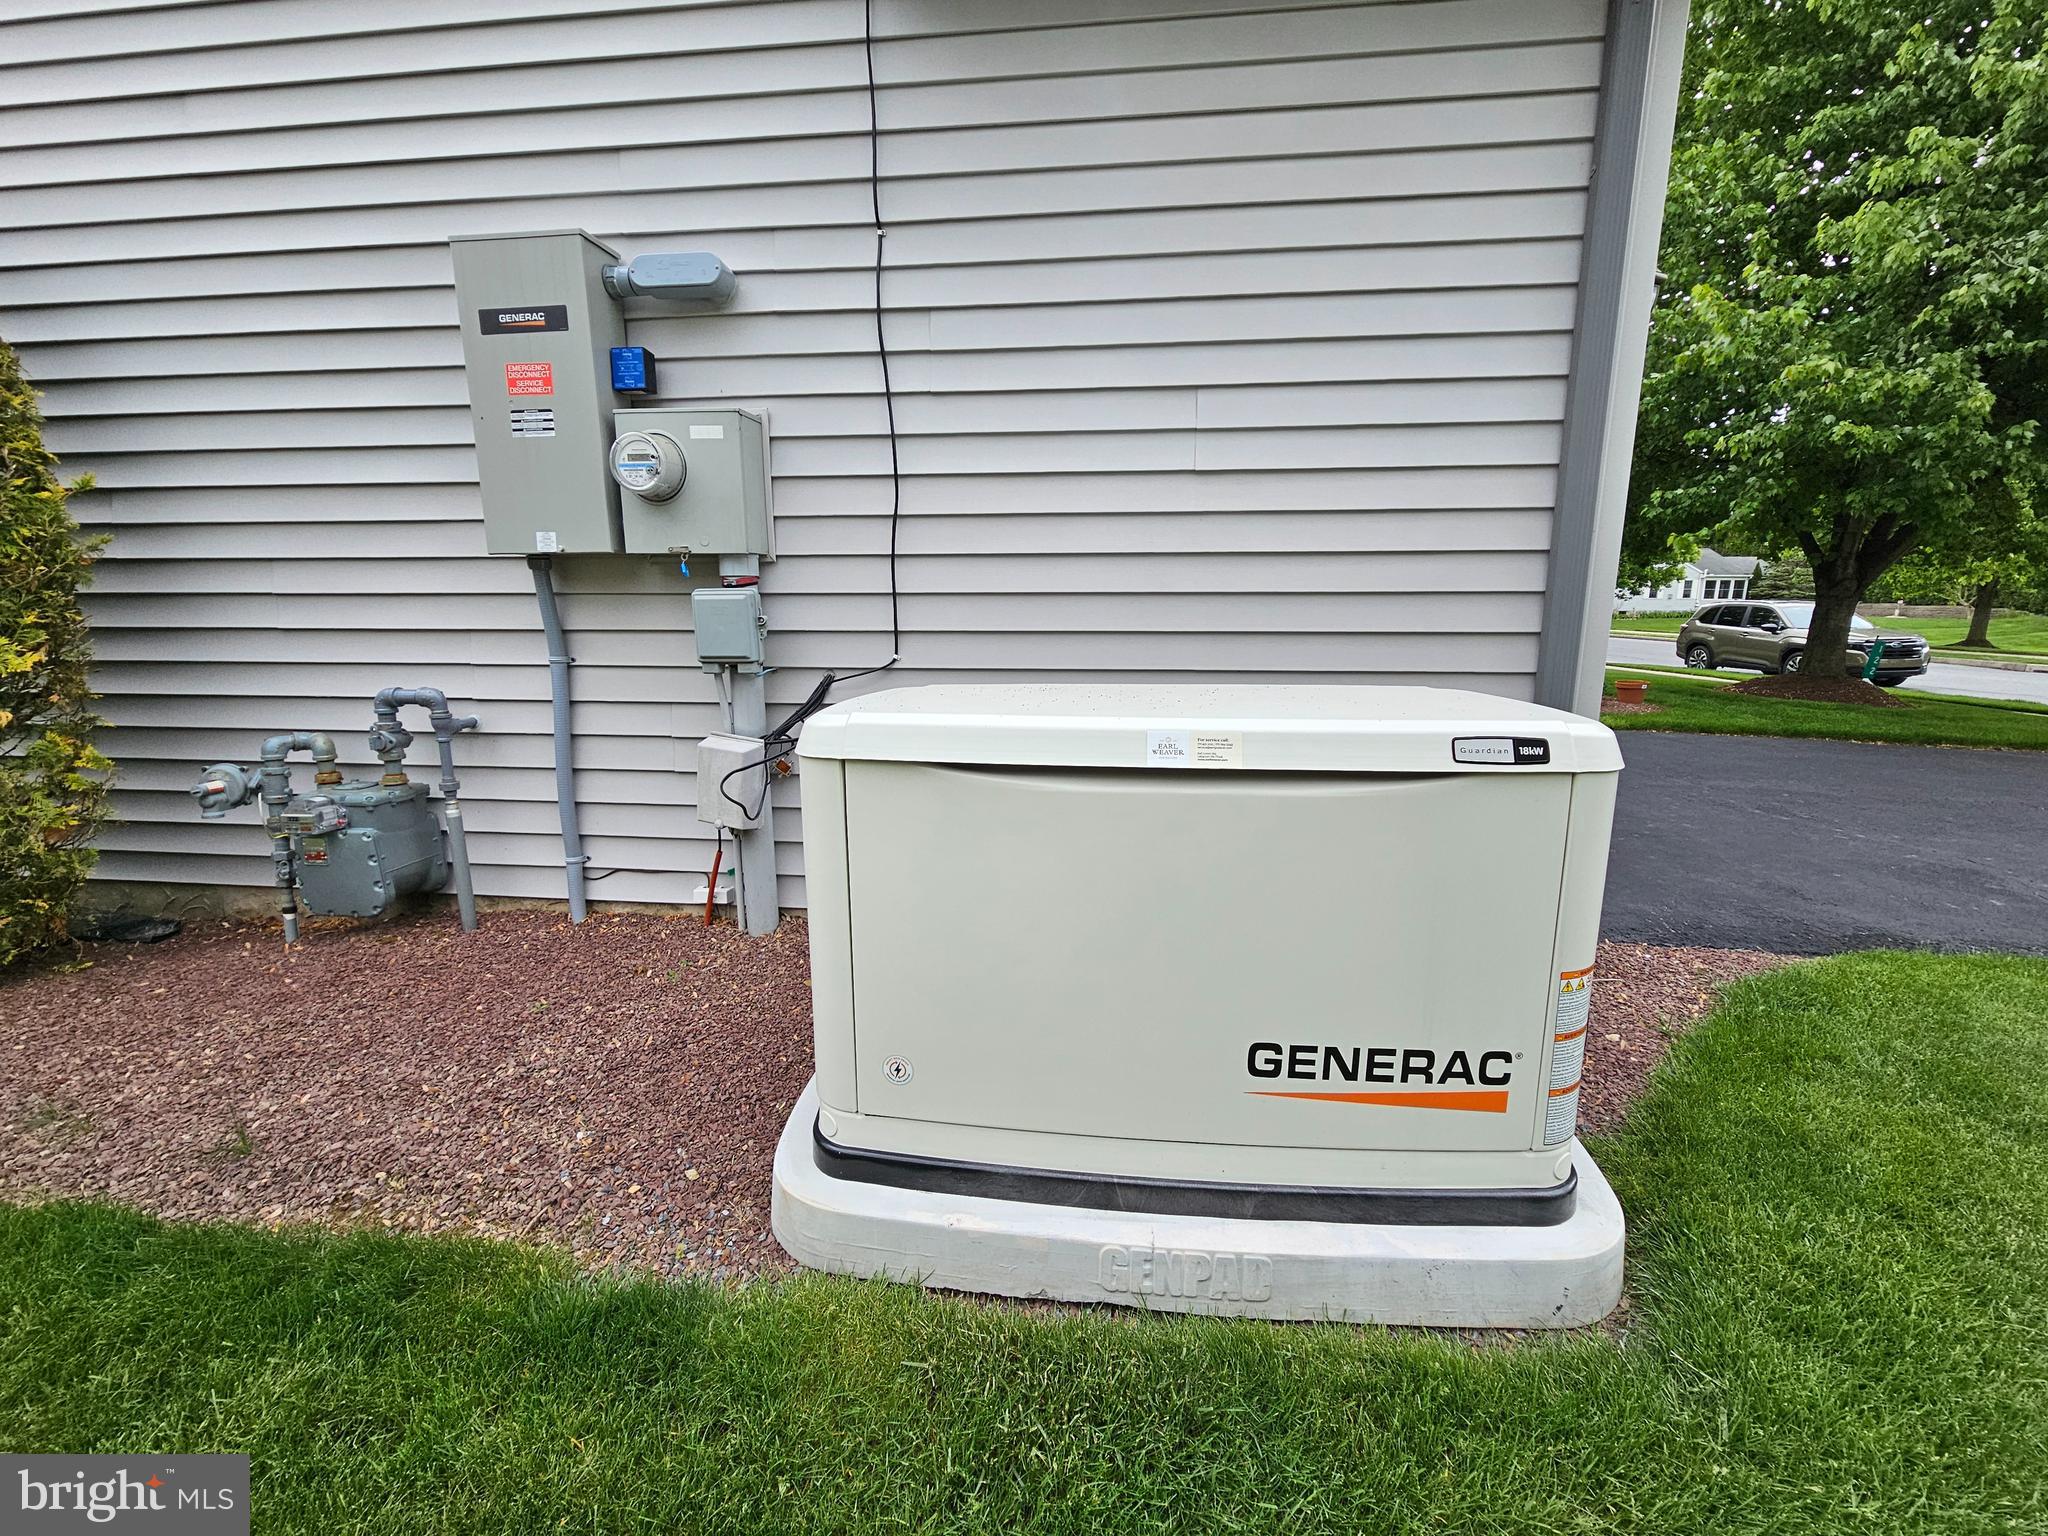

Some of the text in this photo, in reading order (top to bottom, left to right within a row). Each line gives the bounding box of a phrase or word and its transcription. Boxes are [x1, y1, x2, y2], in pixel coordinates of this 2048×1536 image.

[498, 312, 545, 323] GENERAC
[1518, 746, 1544, 756] 18kW
[1247, 1042, 1513, 1086] GENERAC
